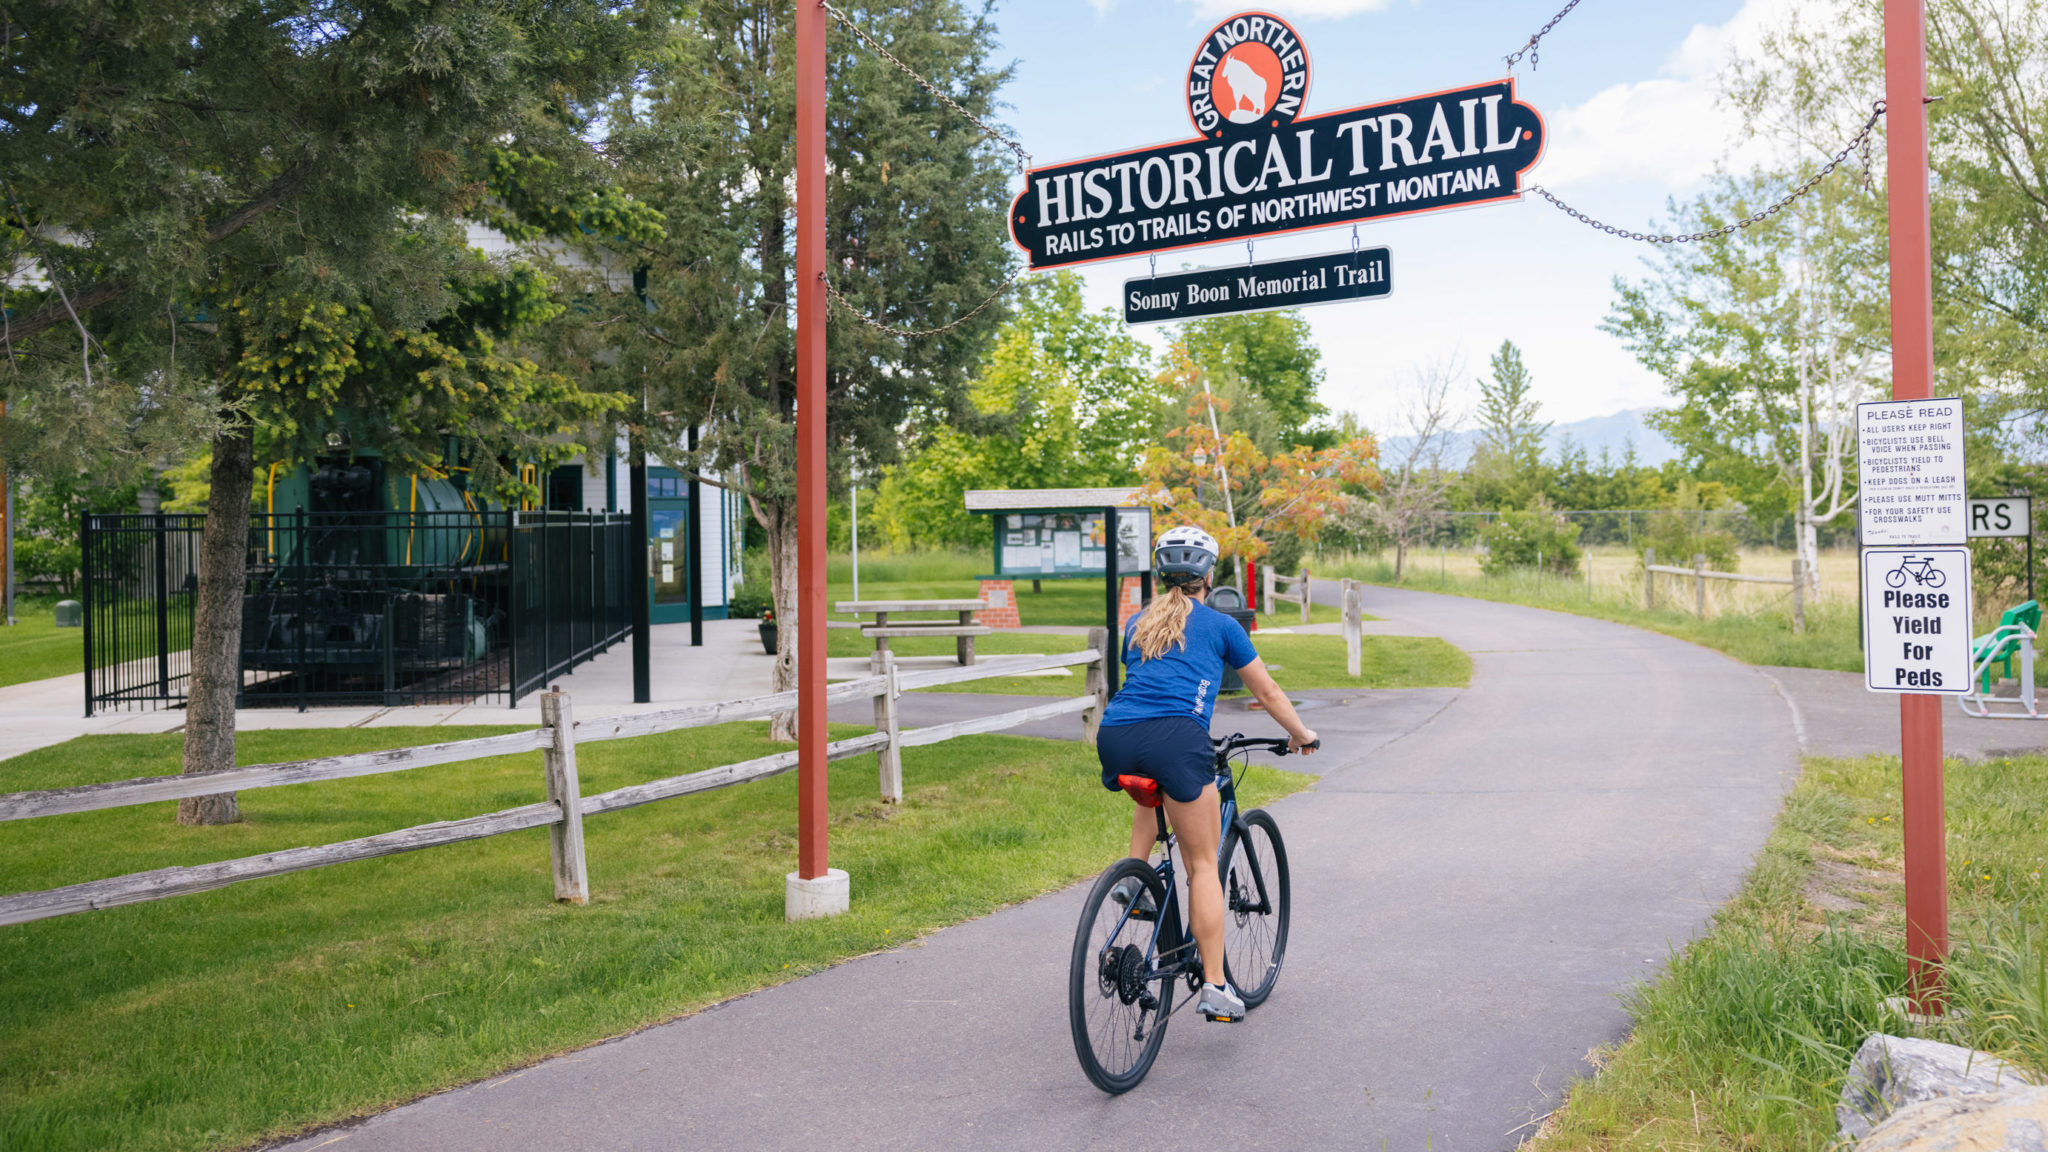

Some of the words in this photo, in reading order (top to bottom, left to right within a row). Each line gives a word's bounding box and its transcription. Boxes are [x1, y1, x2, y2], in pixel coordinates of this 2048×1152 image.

[1190, 42, 1219, 132] GREAT
[1214, 16, 1306, 116] NORTHERN
[1035, 129, 1333, 228] HISTORICAL
[1336, 94, 1522, 176] TRAIL
[1046, 228, 1104, 256] RAILS
[1106, 222, 1134, 246] TO
[1138, 210, 1211, 240] TRAILS
[1216, 204, 1246, 230] OF
[1252, 183, 1381, 225] NORTHWEST
[1386, 164, 1500, 204] MONTANA
[1130, 290, 1180, 312] Sonny
[1187, 284, 1230, 304] Boon
[1238, 268, 1327, 299] Memorial
[1334, 260, 1384, 288] Trail
[1867, 409, 1913, 420] PLEASE
[1920, 408, 1952, 417] READ
[1867, 438, 1907, 446] BICYCLISTS
[1872, 465, 1920, 473] PEDESTRIANS
[1884, 590, 1950, 609] Please
[1893, 616, 1941, 634] Yield
[1904, 642, 1933, 660] For
[1896, 668, 1943, 687] Peds
